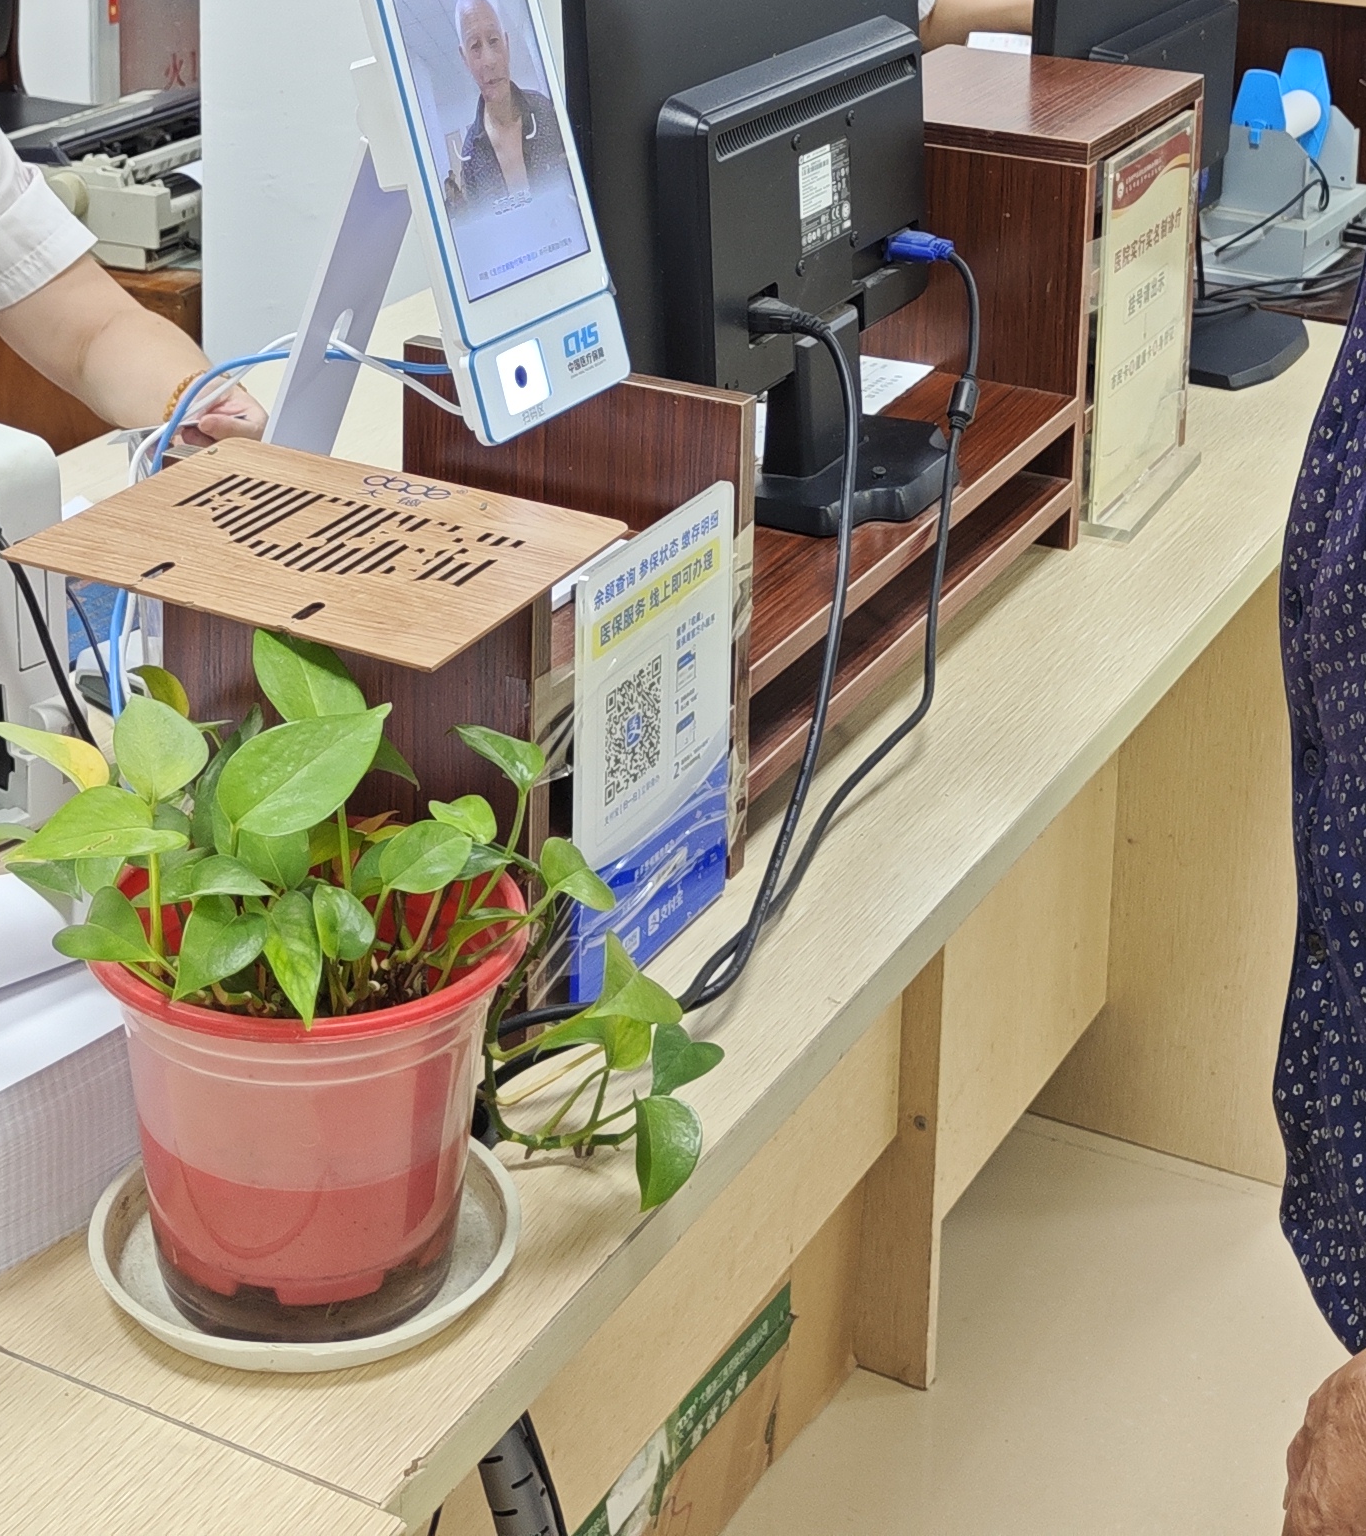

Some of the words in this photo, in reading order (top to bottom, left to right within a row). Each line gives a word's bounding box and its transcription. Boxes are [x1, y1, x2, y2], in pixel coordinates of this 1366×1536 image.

[562, 321, 600, 359] CHS
[593, 566, 637, 612] 余额查询
[638, 537, 680, 581] 参保状态
[680, 509, 720, 551] 缴存明细
[599, 597, 647, 648] 医保服务
[648, 547, 714, 611] 线上即可办理
